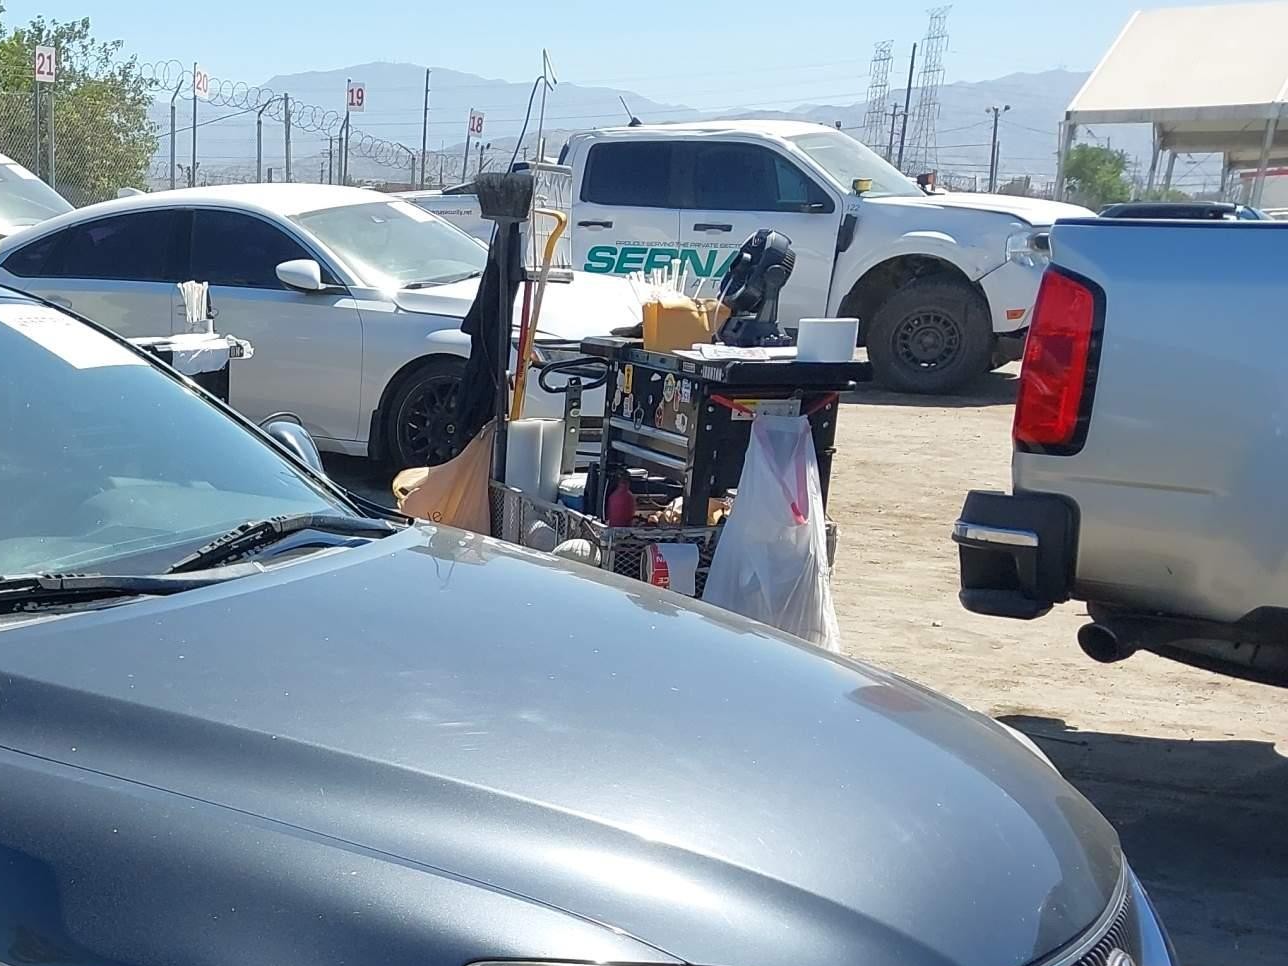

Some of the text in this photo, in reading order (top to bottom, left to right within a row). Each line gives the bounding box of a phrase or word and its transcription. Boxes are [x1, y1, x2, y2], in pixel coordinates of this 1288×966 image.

[37, 53, 53, 75] 21
[196, 71, 208, 93] 20
[349, 88, 364, 106] 19
[471, 116, 483, 133] 18
